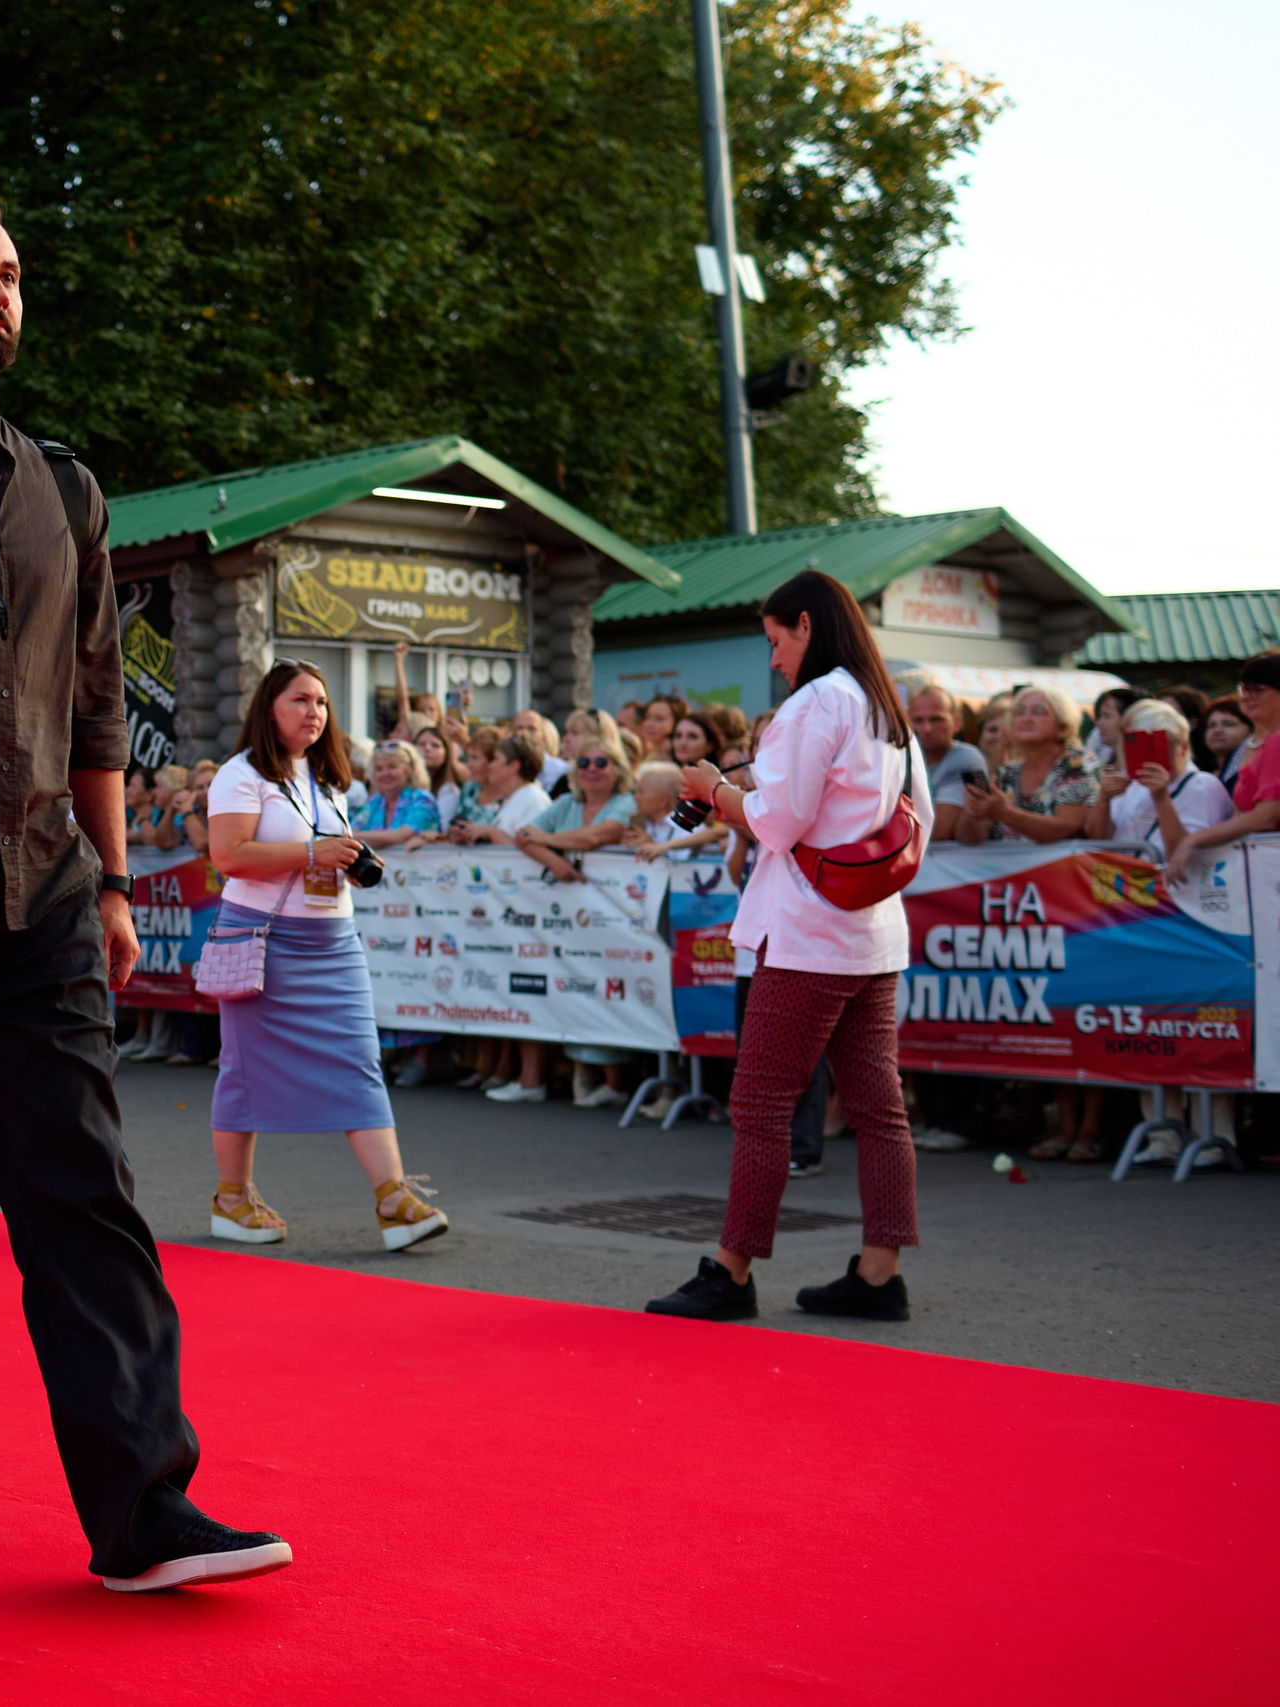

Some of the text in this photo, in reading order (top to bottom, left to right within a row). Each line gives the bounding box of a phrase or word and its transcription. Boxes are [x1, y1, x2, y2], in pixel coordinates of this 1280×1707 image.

[326, 557, 521, 602] SHAUROOM
[367, 598, 470, 622] ГРИЛЬ КАФЕ
[150, 876, 183, 904] НА
[982, 882, 1046, 923] НА
[133, 940, 182, 975] МАХ
[924, 924, 1066, 970] СЕМИ
[896, 972, 1053, 1027] ЛМАХ
[1074, 1003, 1240, 1040] 6-13 АВГУСТА
[1105, 1037, 1176, 1057] КИРОВ
